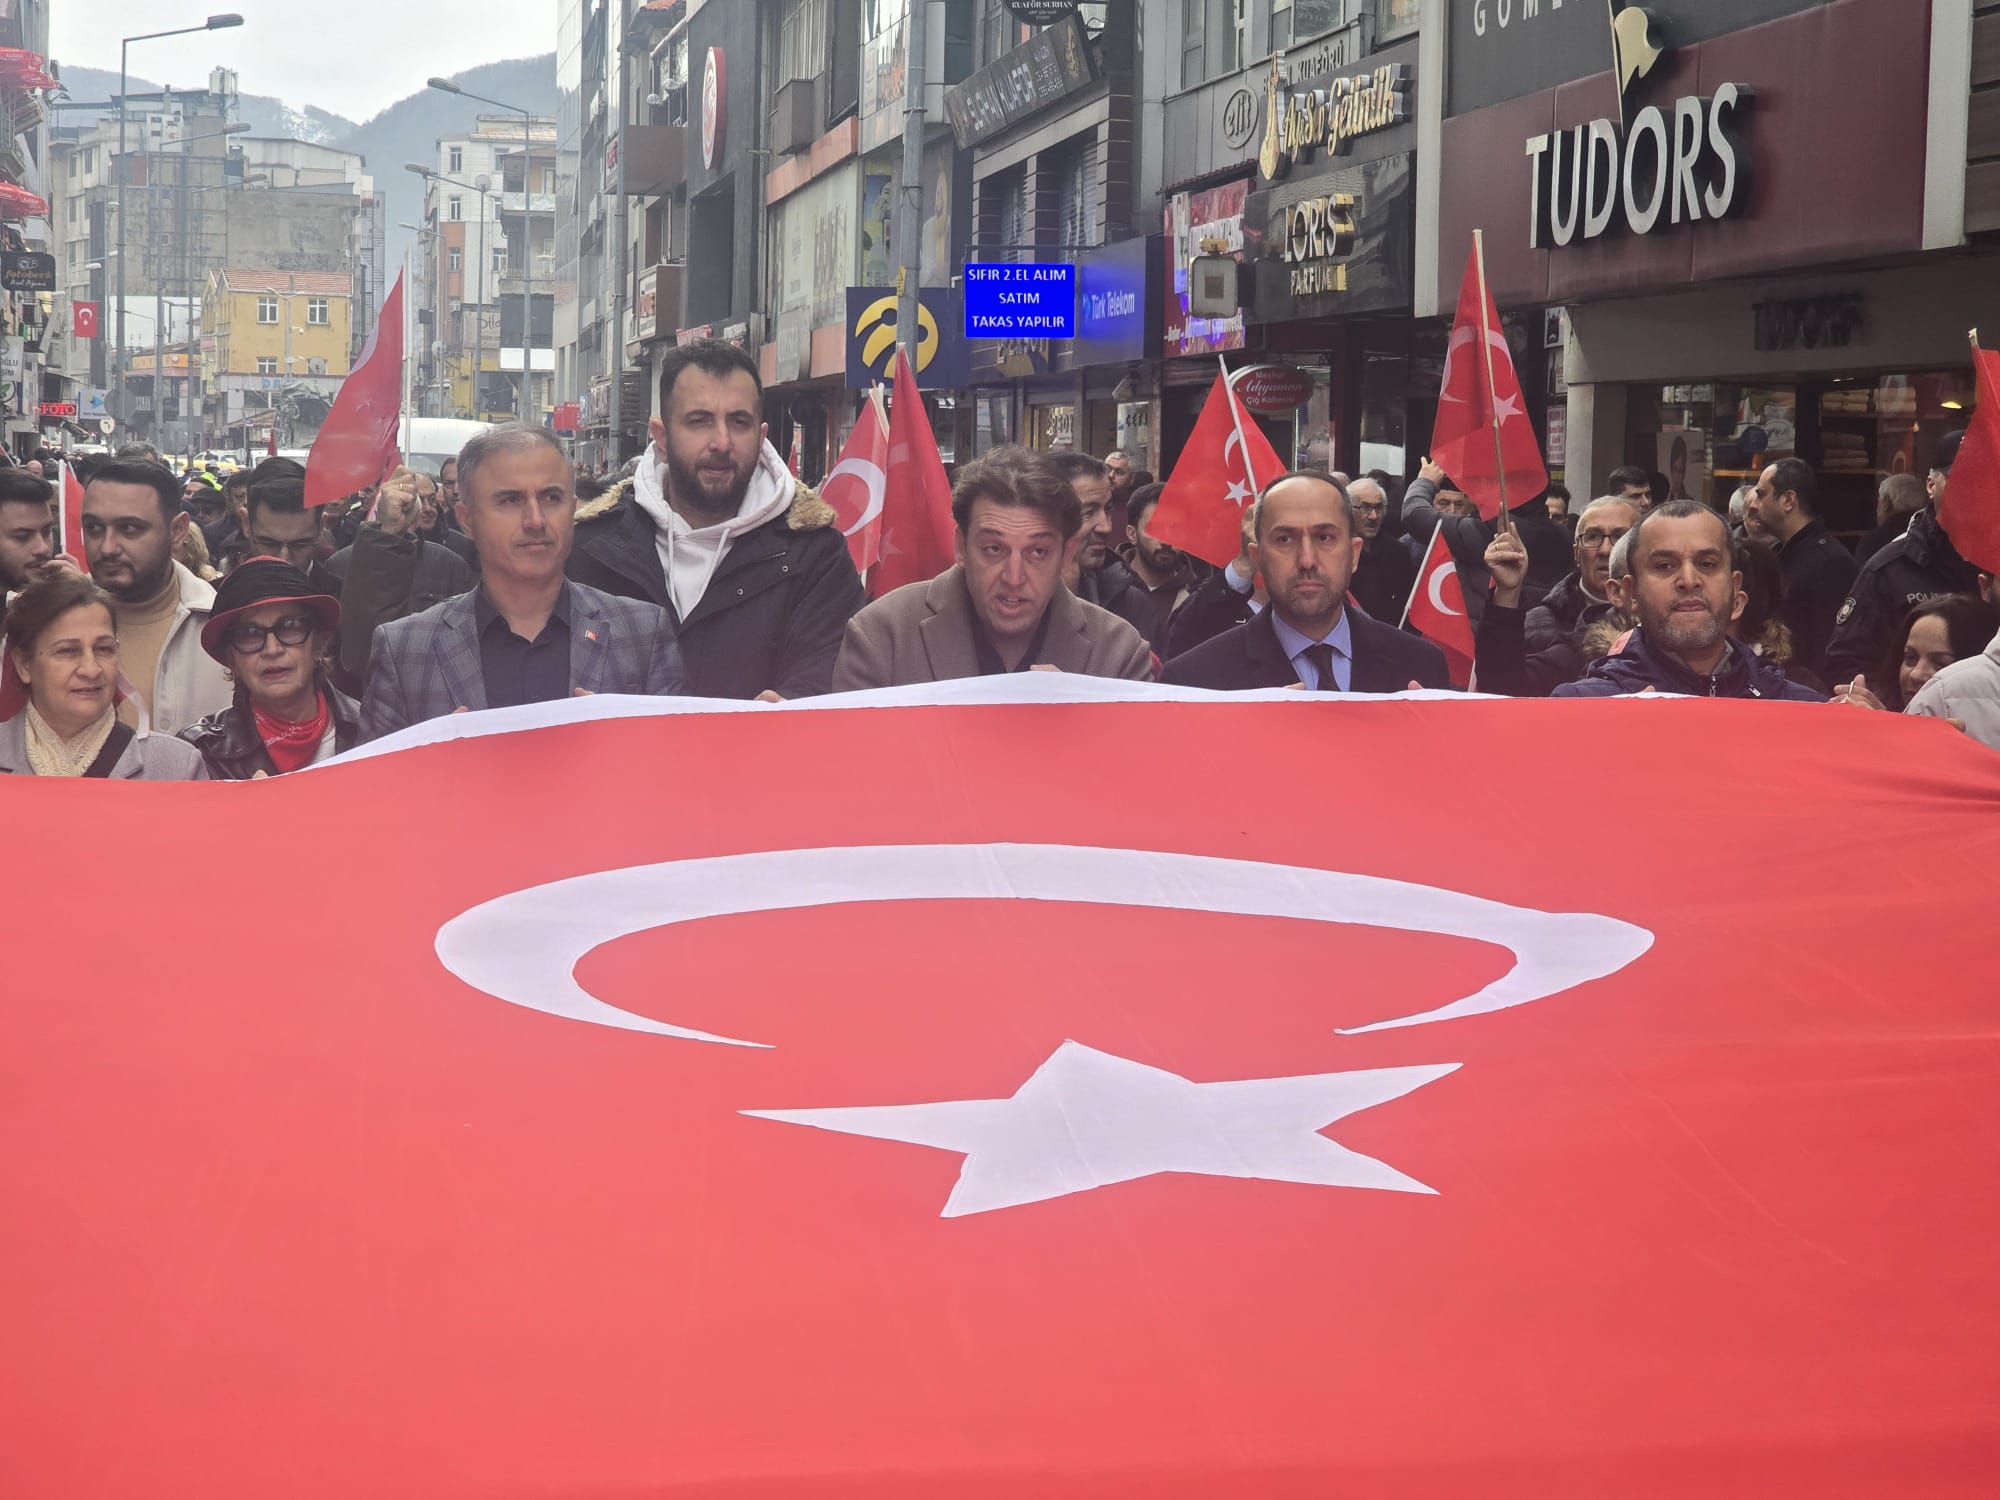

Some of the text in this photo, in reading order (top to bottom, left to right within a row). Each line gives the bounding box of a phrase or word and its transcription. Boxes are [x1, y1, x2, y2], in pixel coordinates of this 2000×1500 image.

[1526, 82, 1738, 249] TUDORS
[1284, 193, 1337, 263] LORIS
[968, 269, 1066, 281] SIFIR 2.EL ALIM
[1290, 265, 1329, 296] PARFUM
[999, 292, 1040, 304] SATIM
[1091, 290, 1135, 320] Türk Telekom
[972, 315, 1065, 328] TAKAS YAPILIR
[42, 404, 75, 415] FOTO
